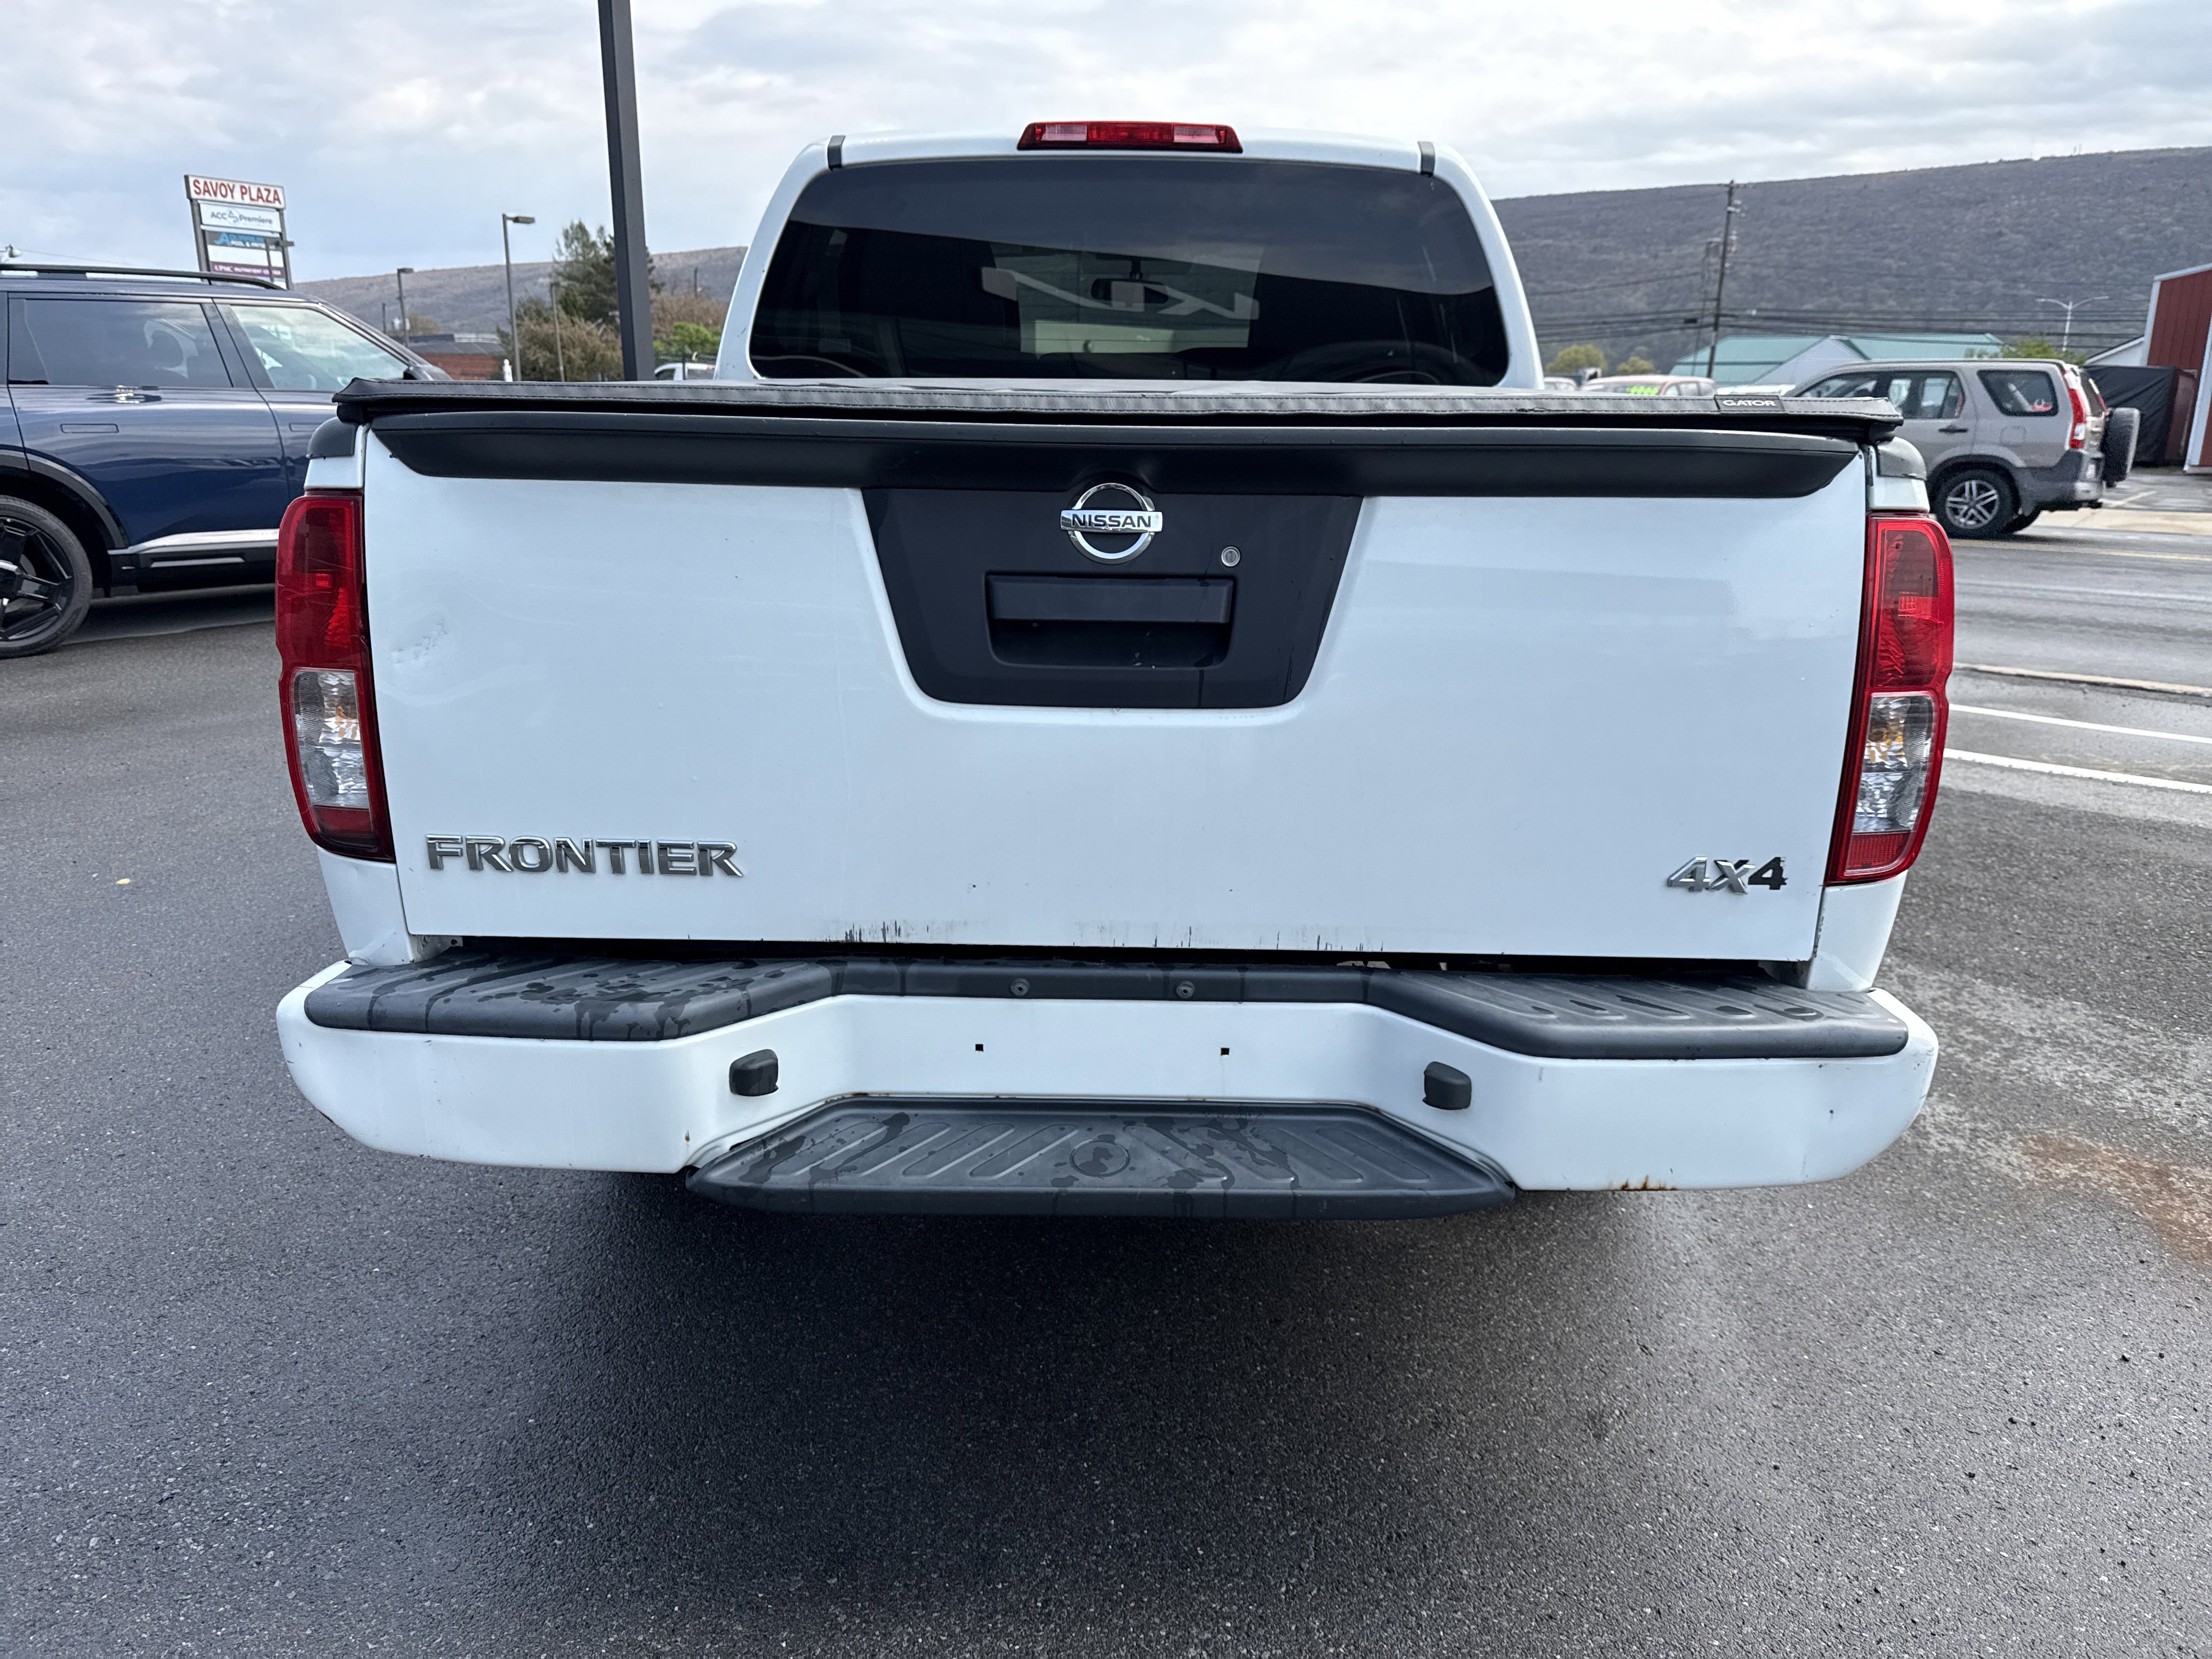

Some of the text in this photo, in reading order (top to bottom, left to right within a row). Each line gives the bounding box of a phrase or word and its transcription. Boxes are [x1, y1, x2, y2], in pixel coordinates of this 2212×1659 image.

[193, 179, 281, 205] SAVOY PLAZA
[211, 211, 227, 220] ACC
[1071, 514, 1152, 528] NISSAN
[426, 834, 743, 878] FRONTIER
